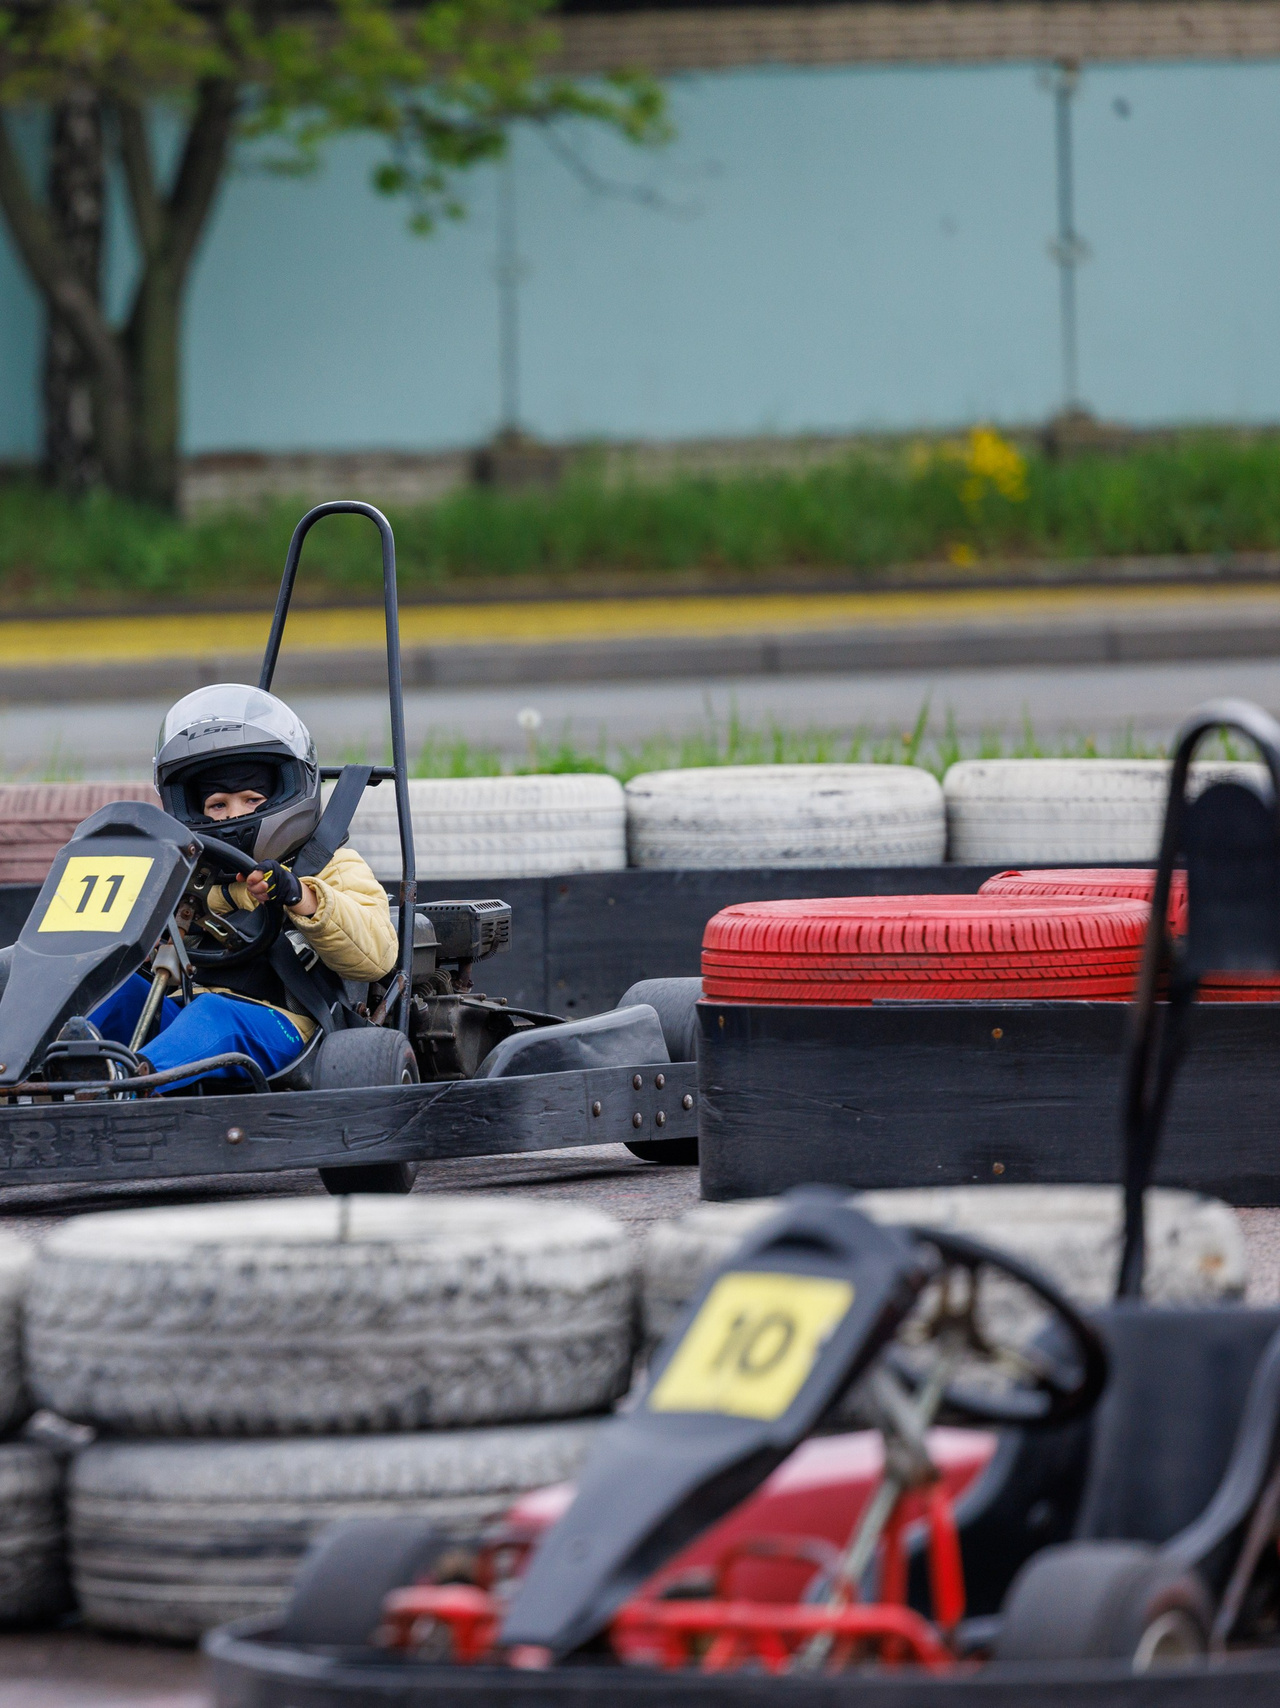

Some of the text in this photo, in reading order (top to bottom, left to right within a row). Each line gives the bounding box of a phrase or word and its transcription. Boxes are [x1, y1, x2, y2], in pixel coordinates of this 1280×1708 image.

[187, 724, 243, 741] LS2
[75, 874, 126, 914] 11
[708, 1311, 797, 1378] 10
